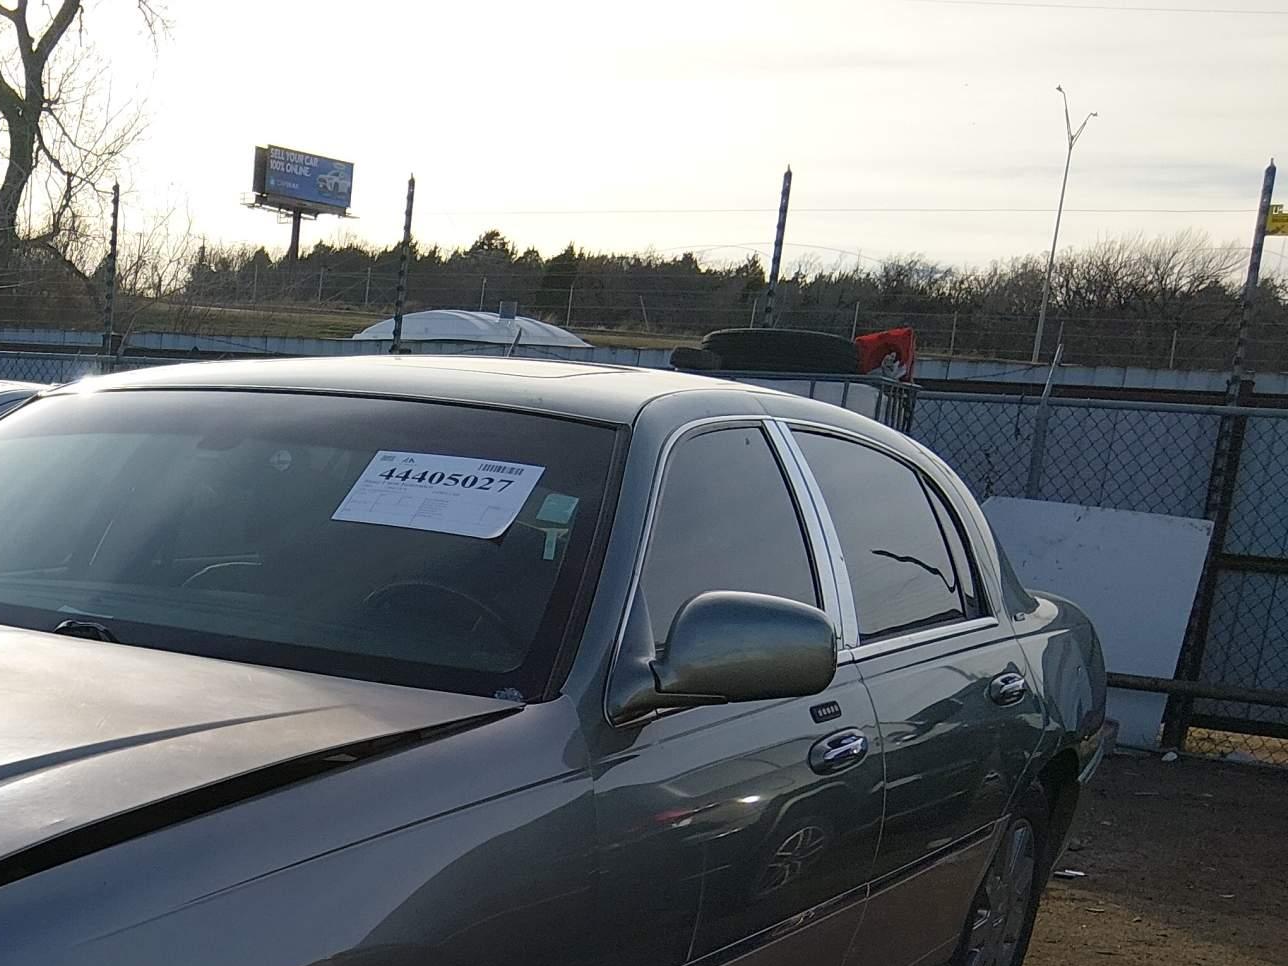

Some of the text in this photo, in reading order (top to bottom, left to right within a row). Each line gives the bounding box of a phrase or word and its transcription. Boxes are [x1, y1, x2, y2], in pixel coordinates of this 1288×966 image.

[270, 148, 284, 161] SELL
[286, 151, 304, 164] YOUR
[285, 163, 312, 177] ONLINE
[379, 467, 515, 493] 44405027
